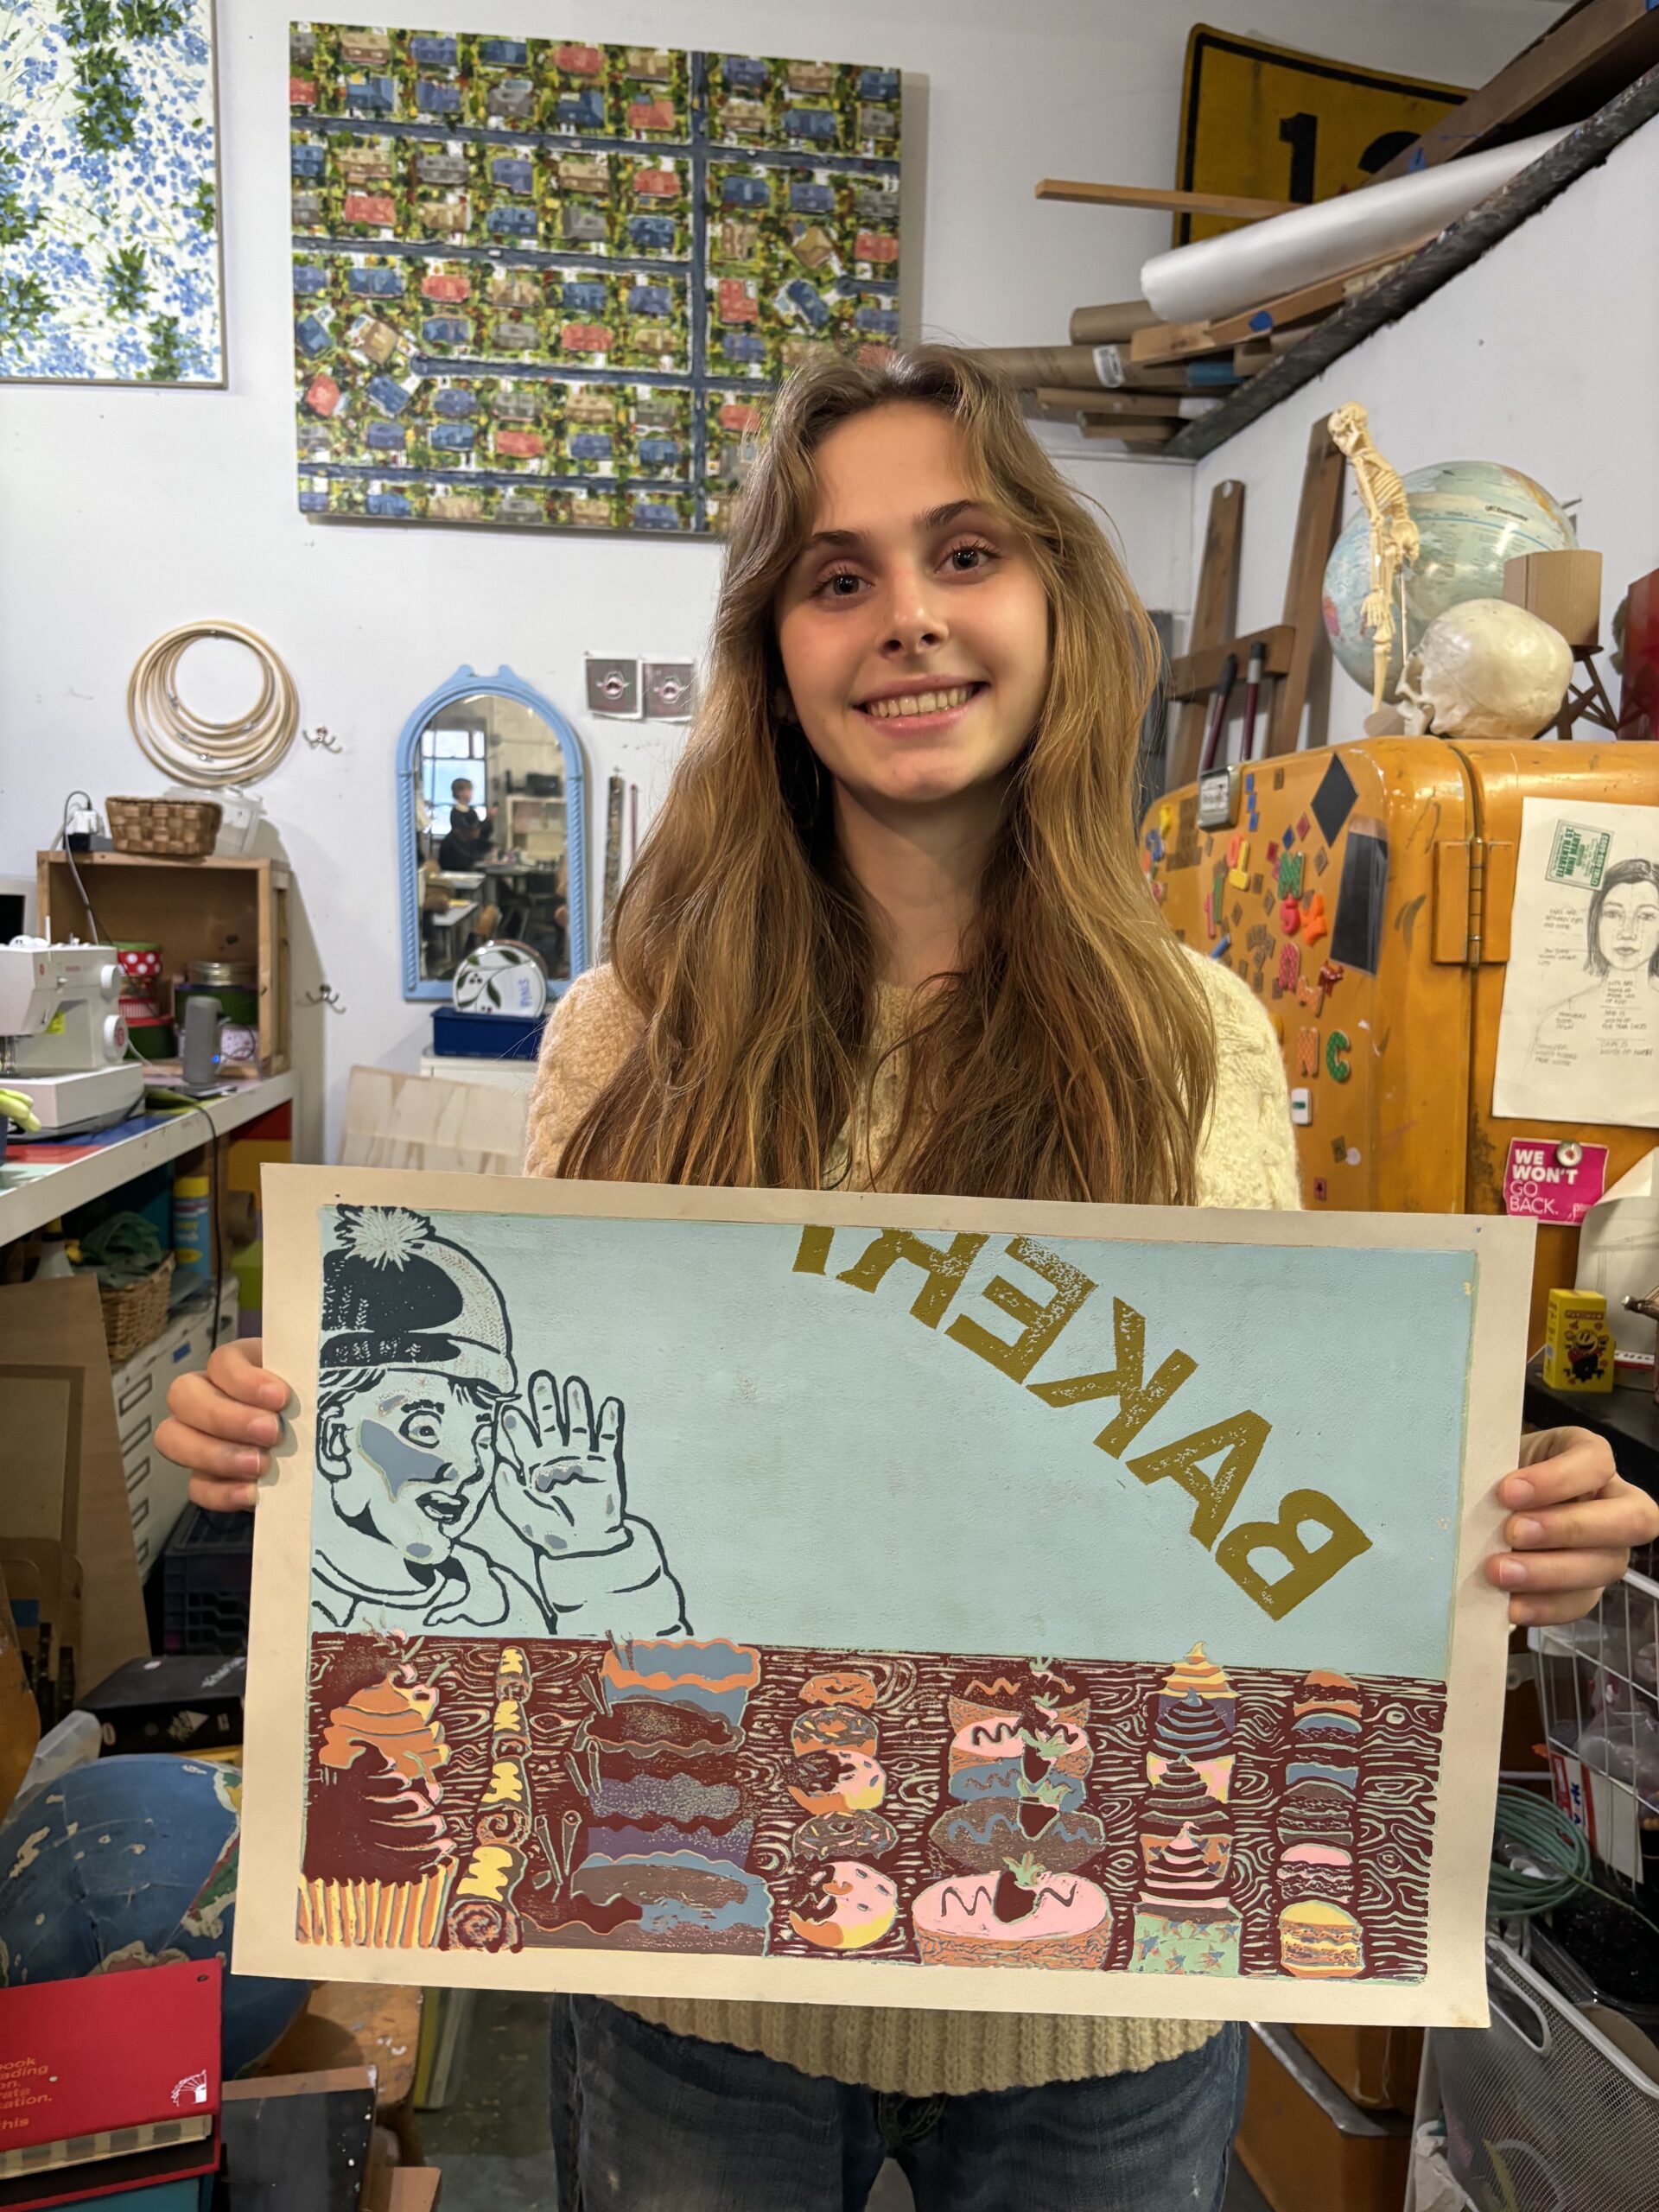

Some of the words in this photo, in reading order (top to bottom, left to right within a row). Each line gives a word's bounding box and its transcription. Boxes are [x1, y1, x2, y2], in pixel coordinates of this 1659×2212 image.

[1570, 831, 1582, 855] MART
[1564, 856, 1577, 876] MINI
[1515, 1148, 1545, 1166] WE
[1512, 1164, 1579, 1185] WON'T
[1510, 1179, 1538, 1198] GO
[1510, 1195, 1559, 1216] BACK.
[0, 2094, 53, 2109] ation.
[0, 2118, 29, 2130] his
